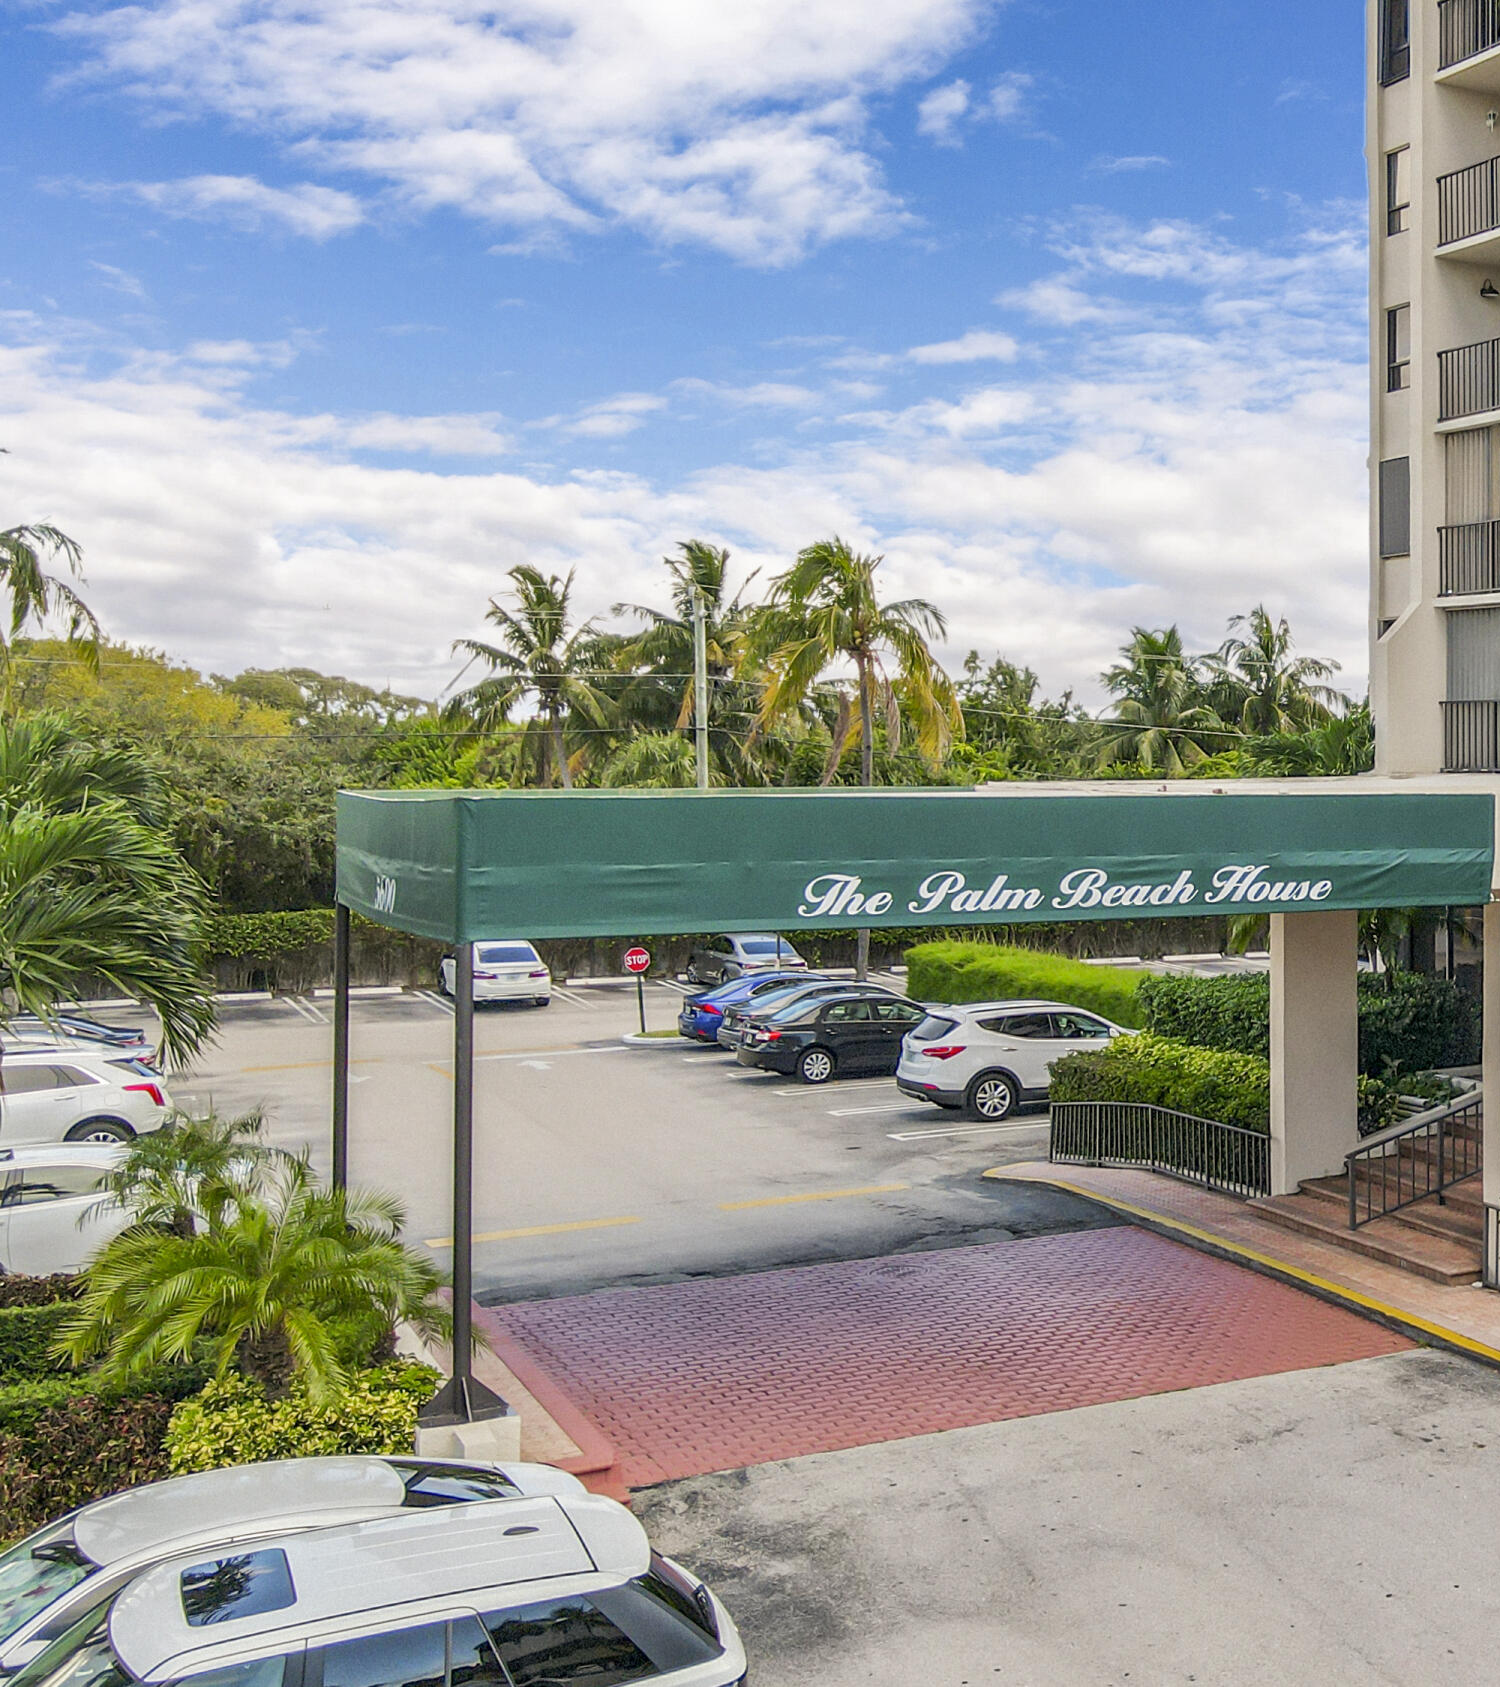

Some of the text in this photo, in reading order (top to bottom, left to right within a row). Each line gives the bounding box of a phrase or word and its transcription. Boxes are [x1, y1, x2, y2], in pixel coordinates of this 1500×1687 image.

[797, 865, 1332, 917] The Palm Beach House
[626, 954, 649, 966] STOP
